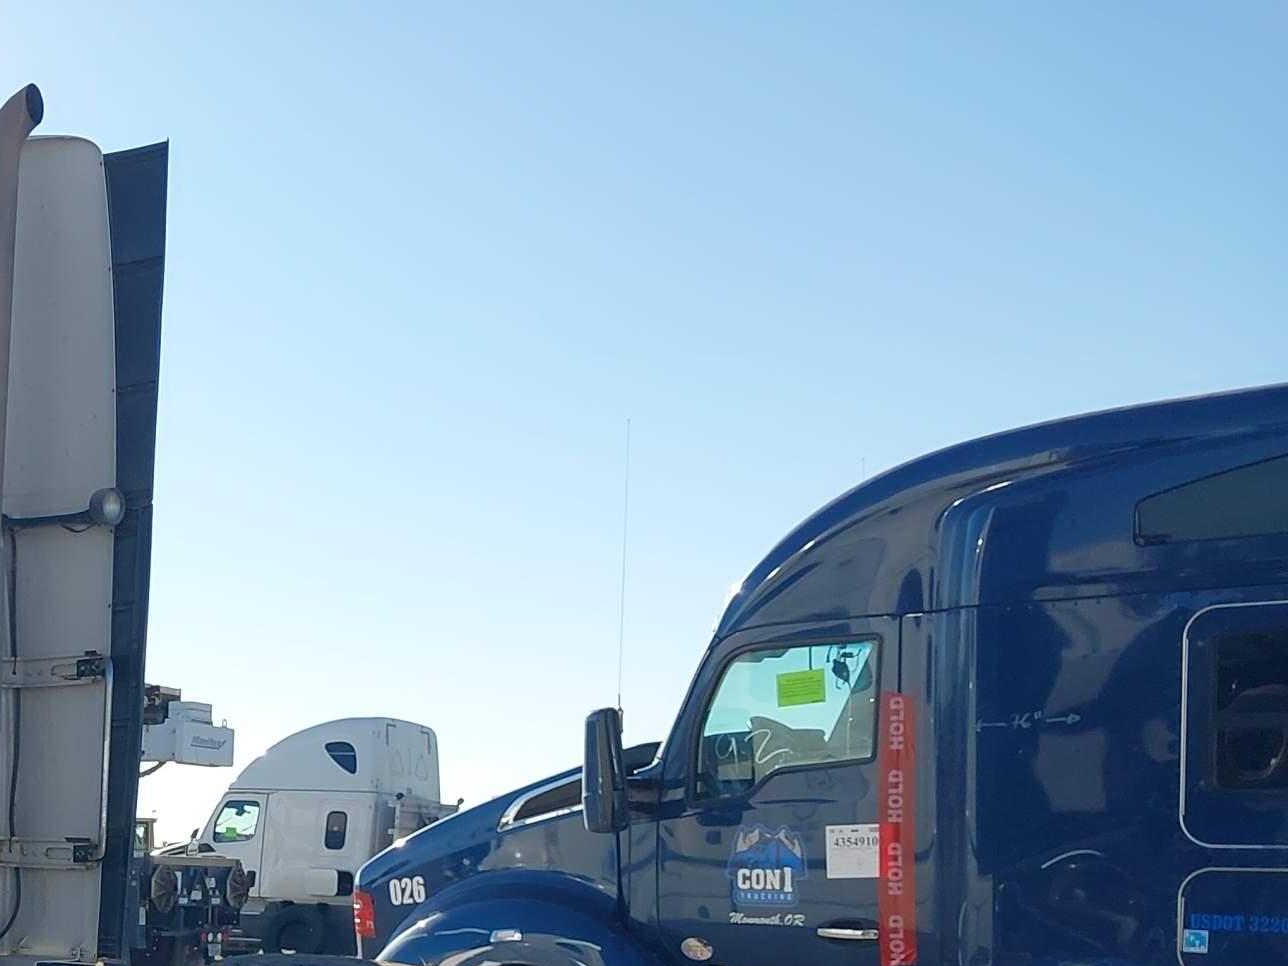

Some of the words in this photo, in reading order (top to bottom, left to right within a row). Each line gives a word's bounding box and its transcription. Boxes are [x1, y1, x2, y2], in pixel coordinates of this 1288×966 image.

[889, 696, 904, 750] HOLD
[887, 769, 903, 822] HOLD
[389, 875, 426, 906] 026
[887, 842, 902, 895] HOLD
[1191, 914, 1244, 932] USDOT
